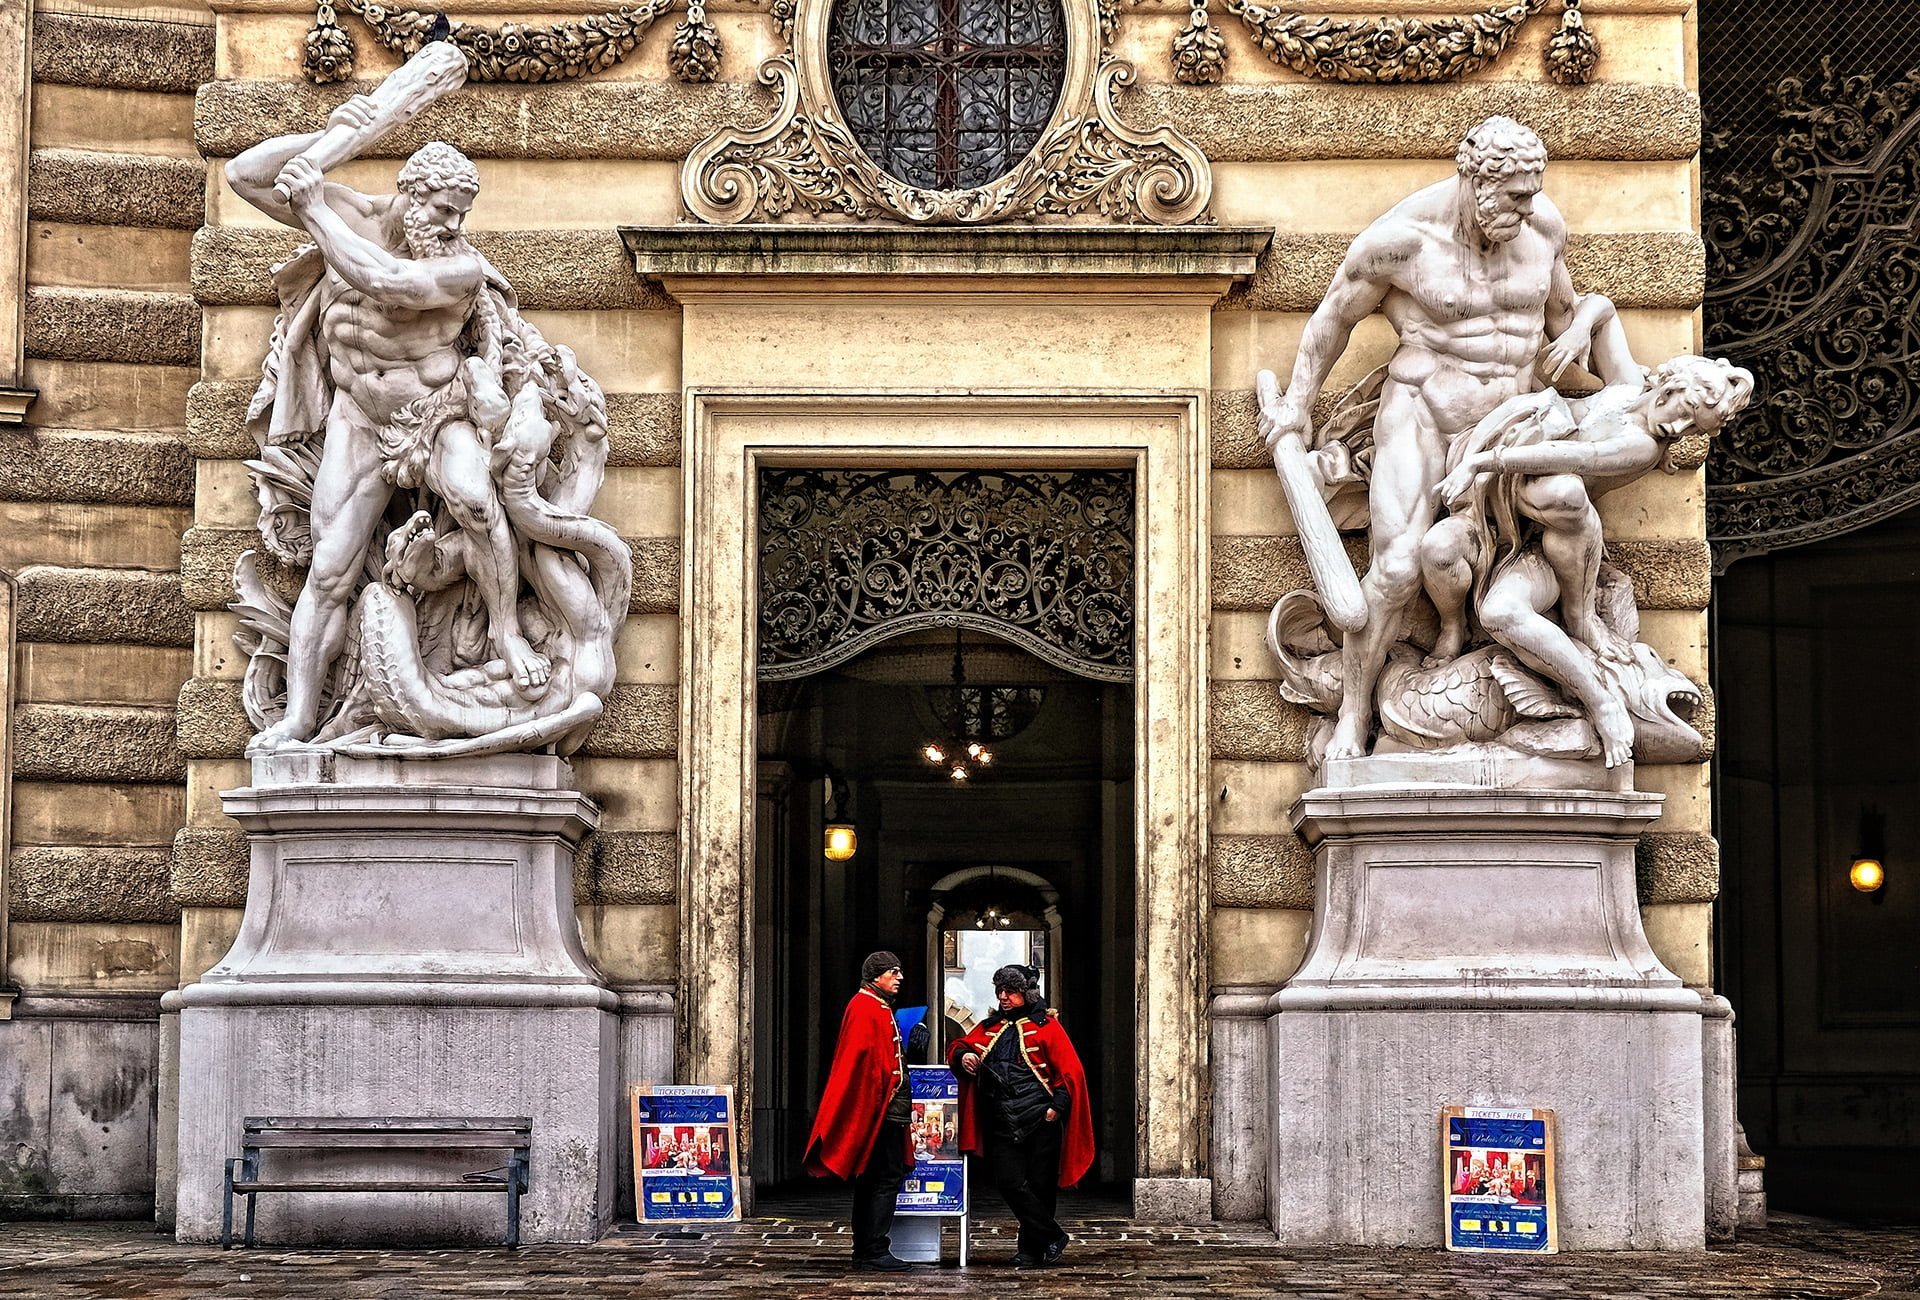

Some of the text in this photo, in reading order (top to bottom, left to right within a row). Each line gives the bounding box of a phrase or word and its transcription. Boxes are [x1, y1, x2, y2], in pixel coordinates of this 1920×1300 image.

[658, 1088, 710, 1096] TICKETS HERE
[1471, 1110, 1527, 1120] TICKETS HERE
[917, 1196, 934, 1204] HERE
